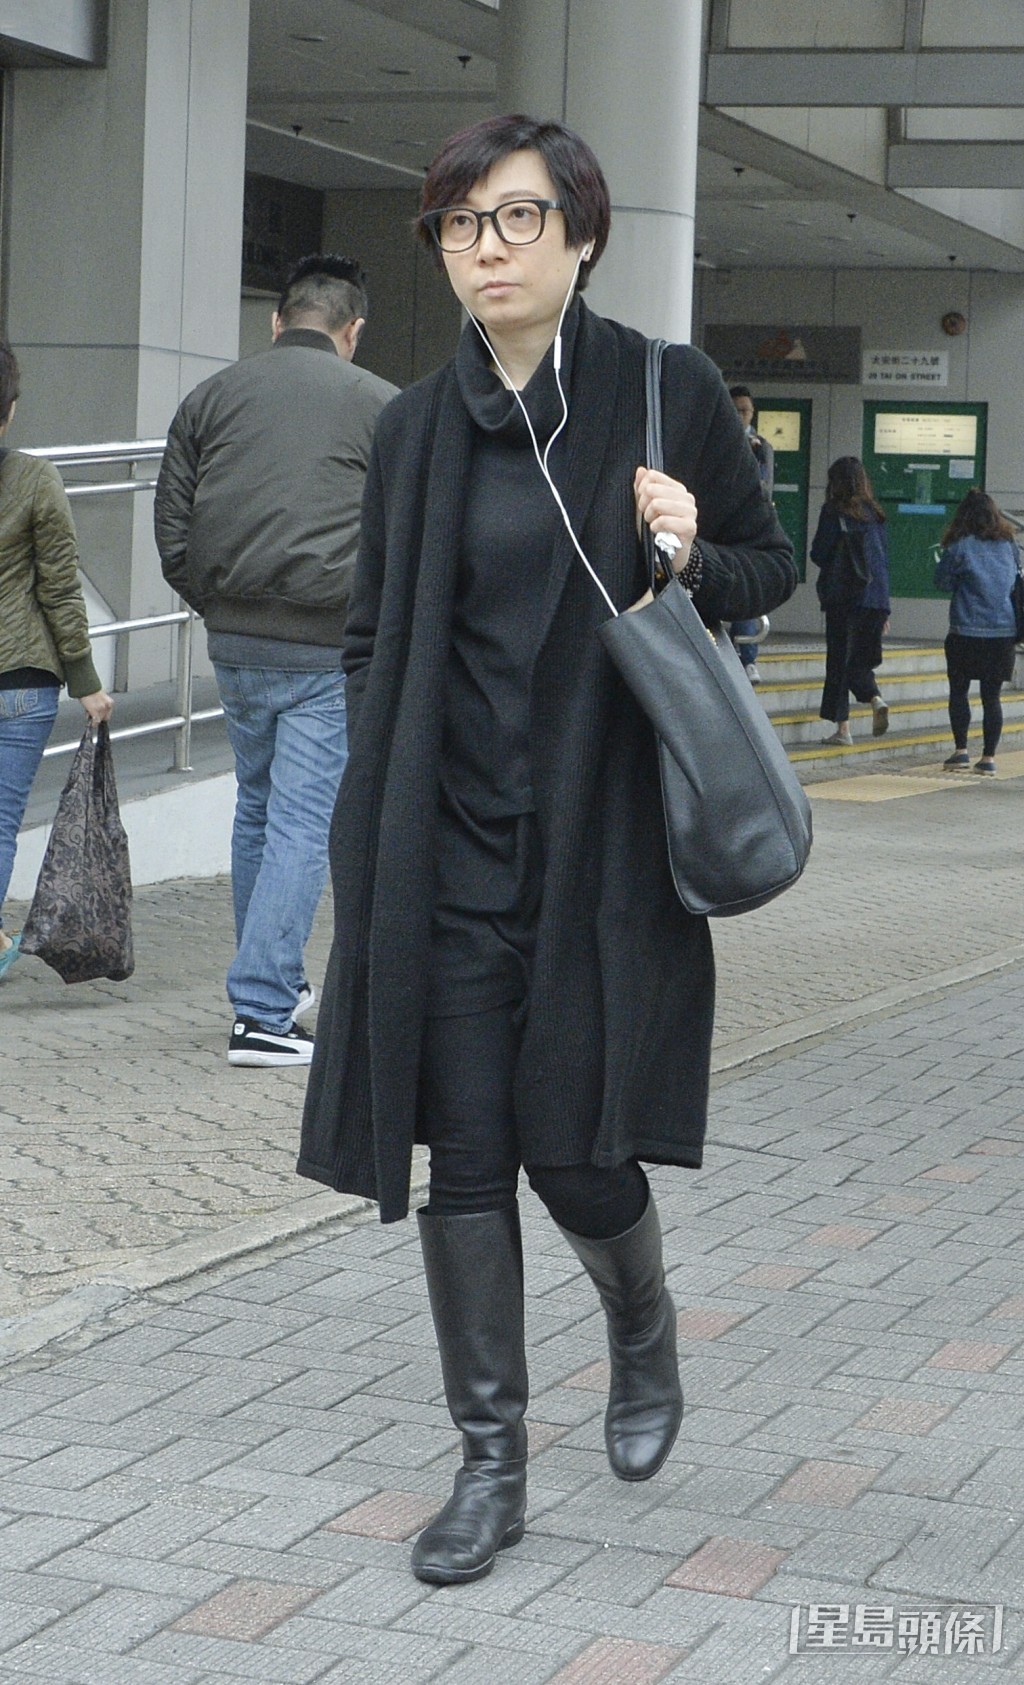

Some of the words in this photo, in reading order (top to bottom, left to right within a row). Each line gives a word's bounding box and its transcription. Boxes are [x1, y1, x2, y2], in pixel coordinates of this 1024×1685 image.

[880, 372, 892, 380] TAI
[895, 373, 907, 381] ON
[910, 373, 941, 381] STREET
